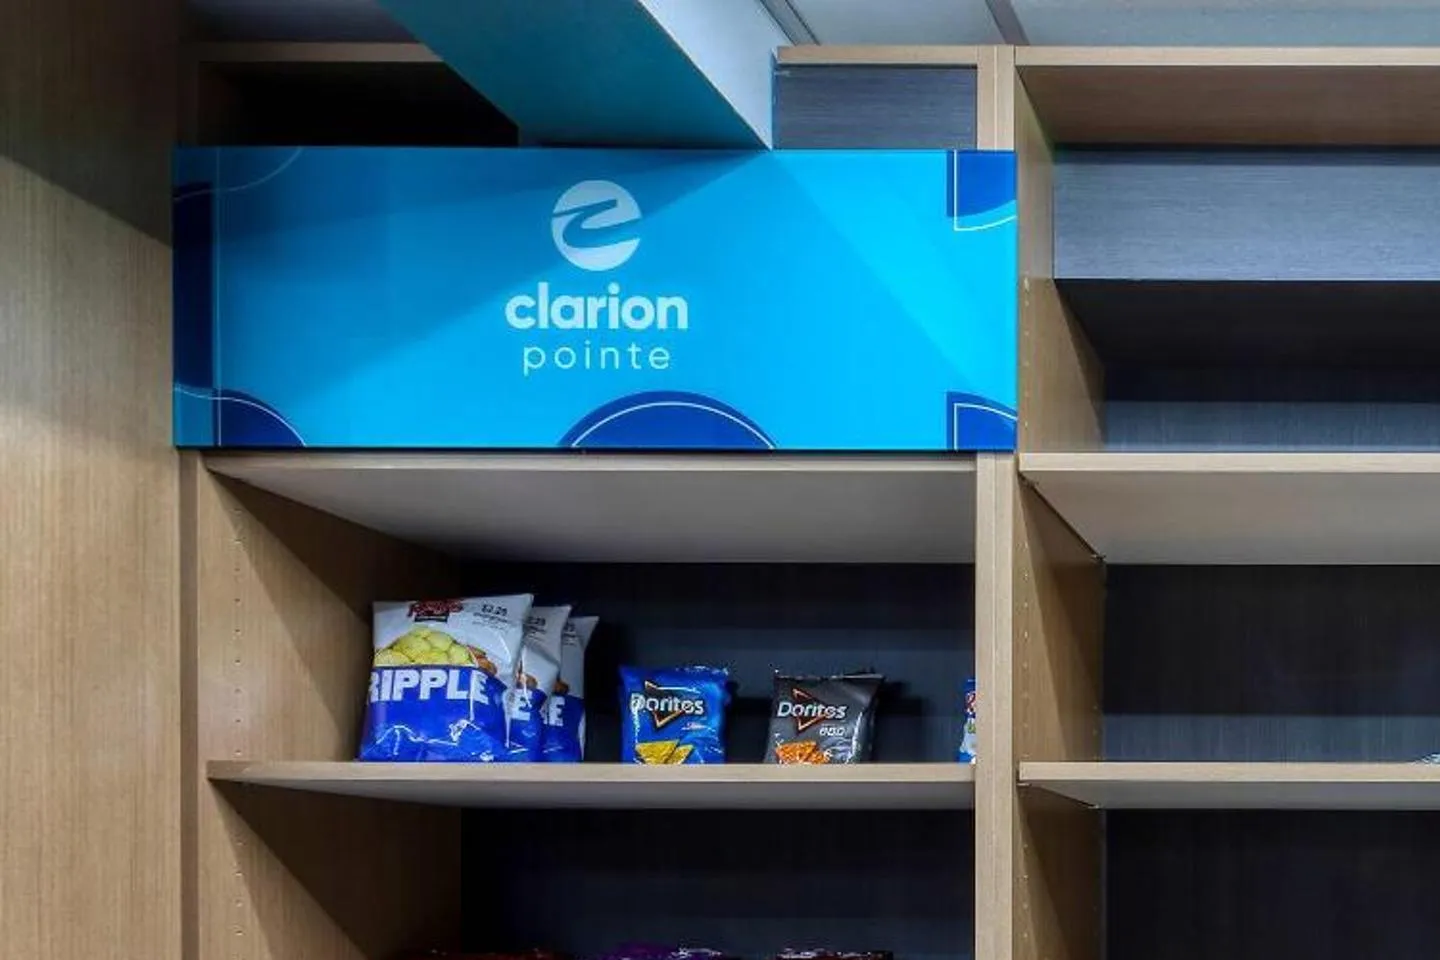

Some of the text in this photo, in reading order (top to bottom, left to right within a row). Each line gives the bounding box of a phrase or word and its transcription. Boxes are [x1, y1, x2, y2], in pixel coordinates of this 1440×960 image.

[504, 281, 690, 330] clarion
[522, 339, 671, 378] pointe
[630, 692, 705, 716] Doritos
[776, 701, 849, 719] Doritos
